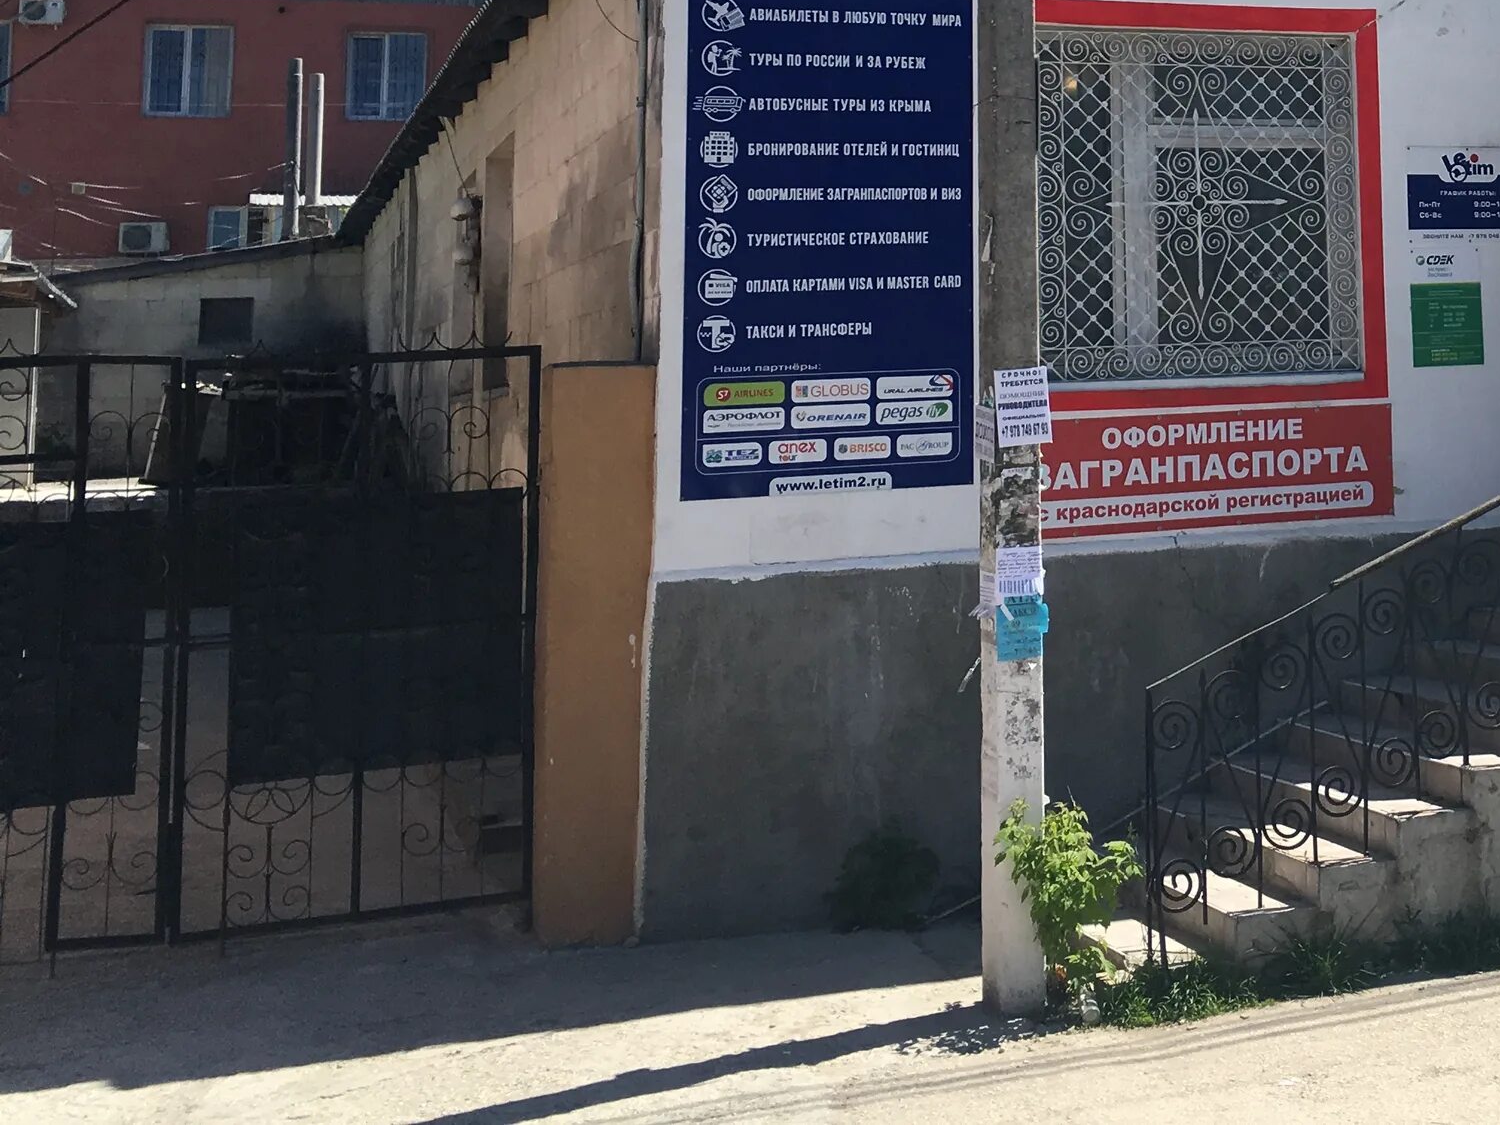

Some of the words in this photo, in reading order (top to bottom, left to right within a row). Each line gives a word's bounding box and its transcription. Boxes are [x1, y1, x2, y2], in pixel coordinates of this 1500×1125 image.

[749, 9, 829, 23] АВИАБИЛЕТЫ
[832, 11, 839, 23] В
[843, 11, 887, 24] ЛЮБУЮ
[890, 13, 926, 25] ТОЧКУ
[932, 14, 962, 27] МИРА
[749, 53, 783, 66] ТУРЫ
[787, 54, 801, 67] ПО
[805, 54, 850, 68] РОССИИ
[855, 56, 863, 68] И
[867, 56, 882, 68] ЗА
[886, 57, 926, 69] РУБЕЖ
[749, 98, 828, 112] АВТОБУСНЫЕ
[832, 99, 866, 112] ТУРЫ
[870, 99, 885, 112] ИЗ
[889, 99, 931, 113] КРЫМА
[748, 143, 839, 156] БРОНИРОВАНИЕ
[843, 141, 888, 156] ОТЕЛЕЙ
[891, 143, 898, 156] И
[902, 143, 960, 158] ГОСТИНИЦ
[1441, 152, 1494, 177] Letim
[747, 188, 824, 201] ОФОРМЛЕНИЕ
[827, 187, 927, 201] ЗАГРАНПАСПОРТОВ
[930, 188, 938, 200] И
[941, 187, 962, 200] ВИЗ
[747, 233, 845, 247] ТУРИСТИЧЕСКОЕ
[849, 231, 929, 245] СТРАХОВАНИЕ
[1426, 255, 1454, 265] CDEK
[746, 279, 789, 293] ОПЛАТА
[793, 278, 845, 292] КАРТАМИ
[849, 277, 873, 290] VISA
[876, 277, 884, 290] И
[887, 276, 930, 290] MASTER
[934, 275, 962, 288] CARD
[746, 324, 784, 339] ТАКСИ
[789, 325, 796, 337] И
[800, 322, 872, 337] ТРАНСФЕРЫ
[713, 365, 751, 373] Наши
[1001, 378, 1043, 387] ТРЕБУЕТСЯ
[734, 389, 774, 398] AIRLINES
[811, 383, 869, 398] GLOBUS
[707, 411, 782, 422] АЭРОФЛОТ
[806, 413, 867, 422] ORENAIR
[880, 406, 923, 422] pegas
[1102, 418, 1303, 449] ОФОРМЛЕНИЕ
[778, 442, 817, 454] anex
[849, 443, 887, 453] BRISCO
[776, 477, 886, 492] www.letim2.ru
[1056, 494, 1219, 523] краснодарской
[1226, 484, 1364, 513] регистрацией
